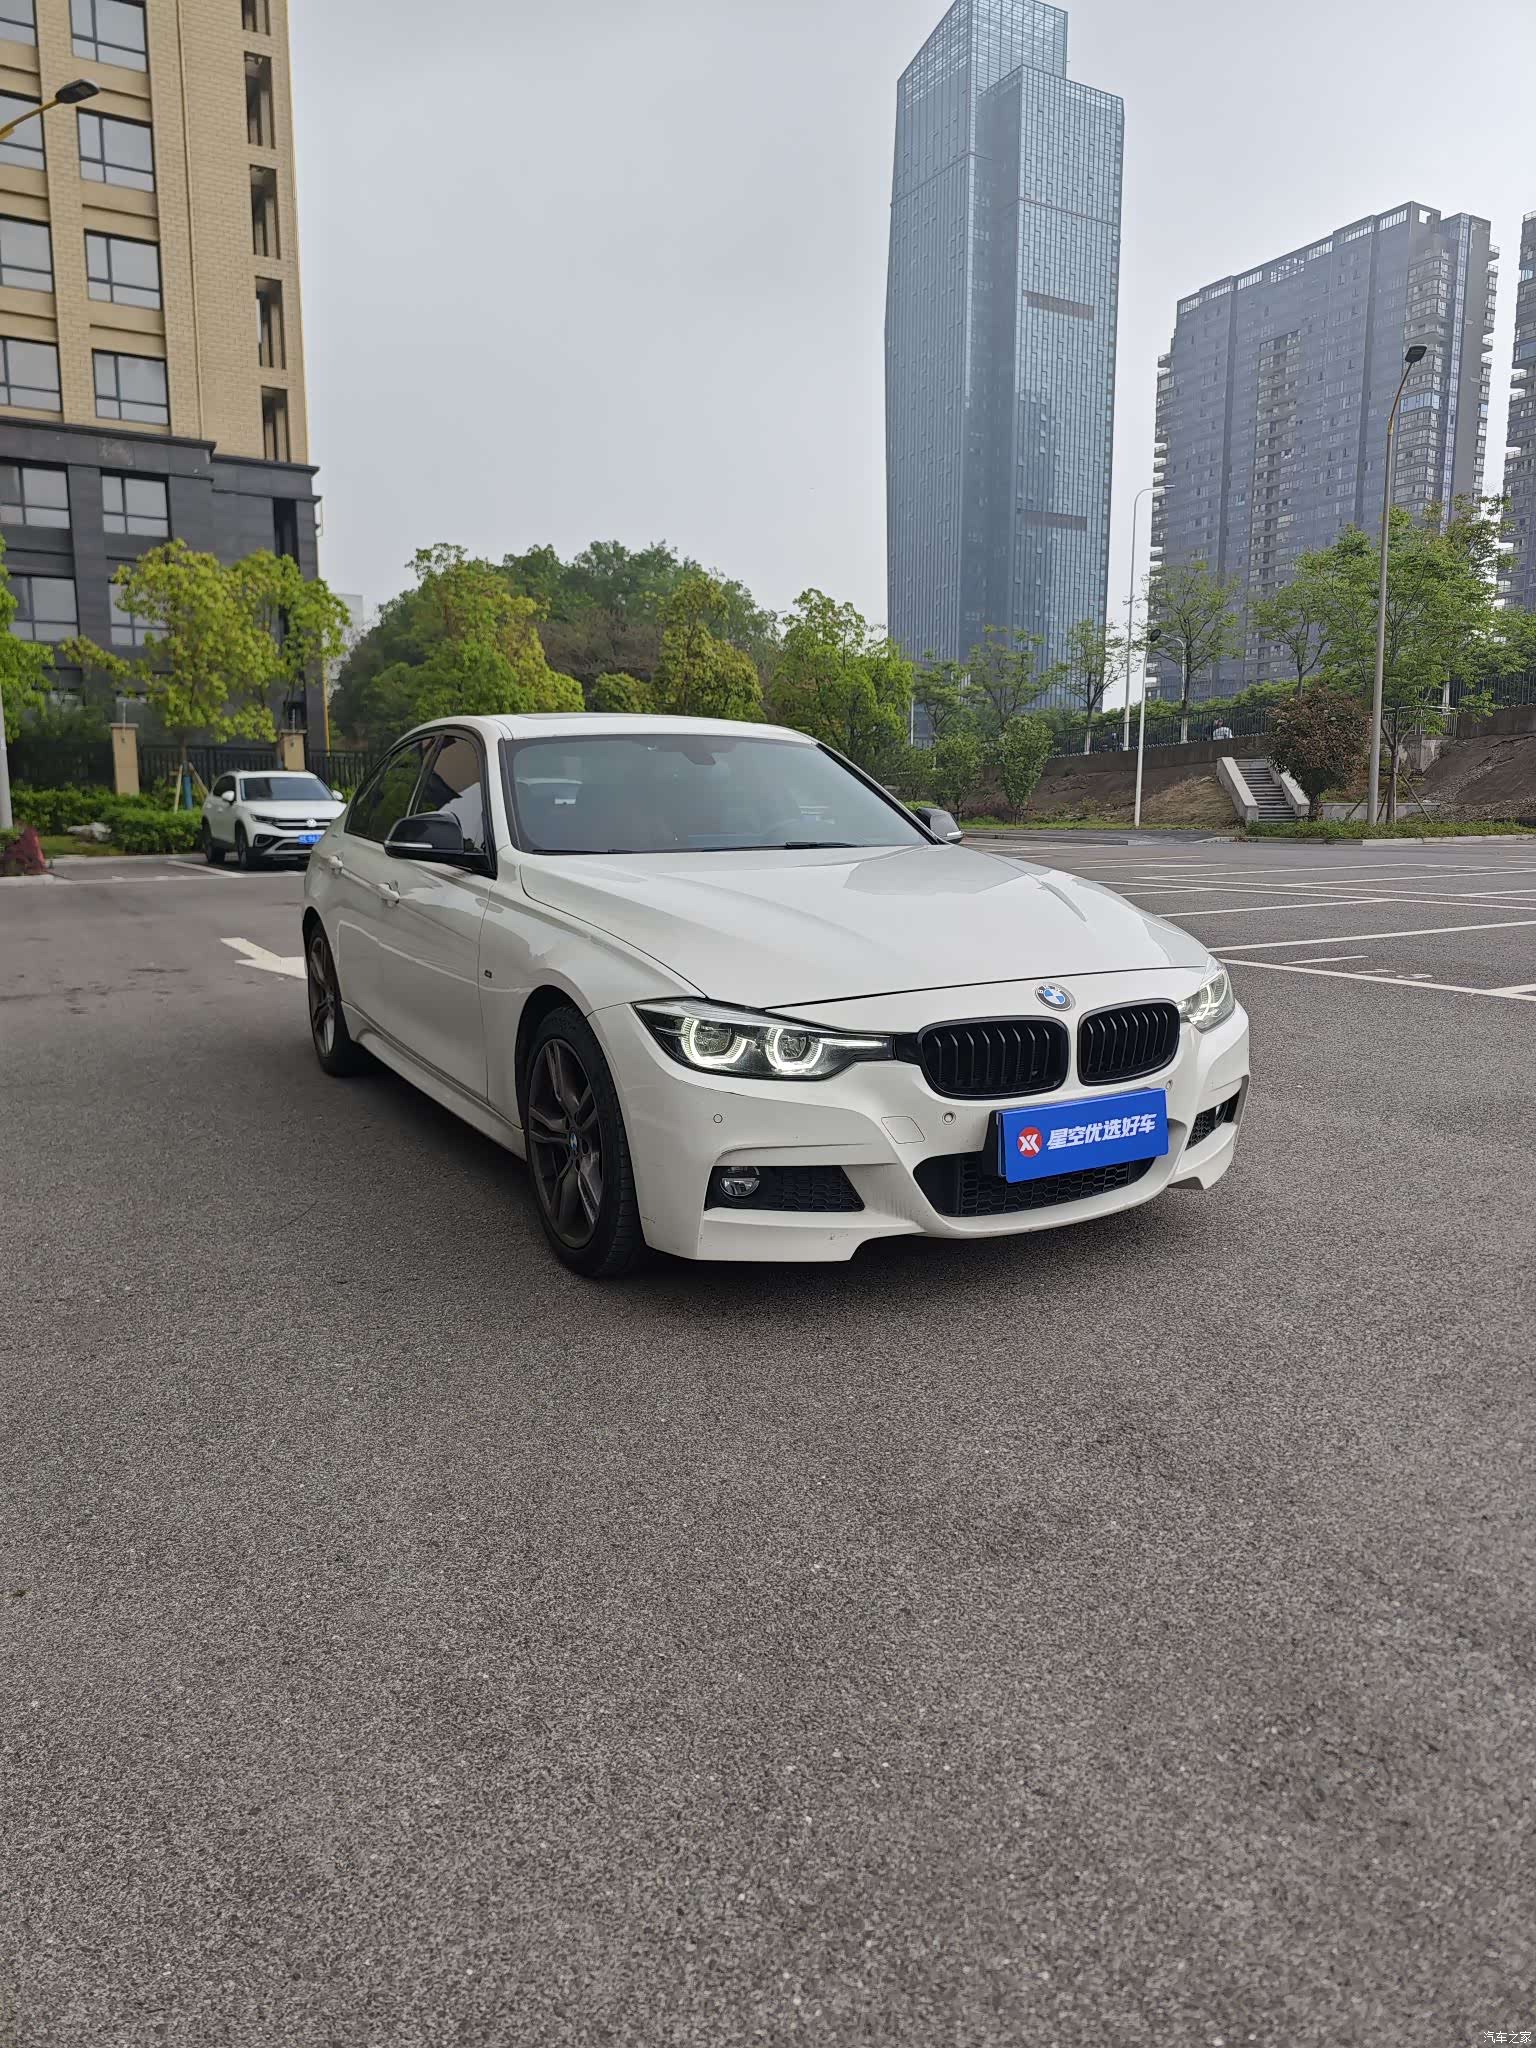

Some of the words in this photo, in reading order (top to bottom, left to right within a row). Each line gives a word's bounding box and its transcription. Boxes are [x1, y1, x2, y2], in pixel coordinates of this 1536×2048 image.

[1046, 1113, 1157, 1150] 星空优选好车
